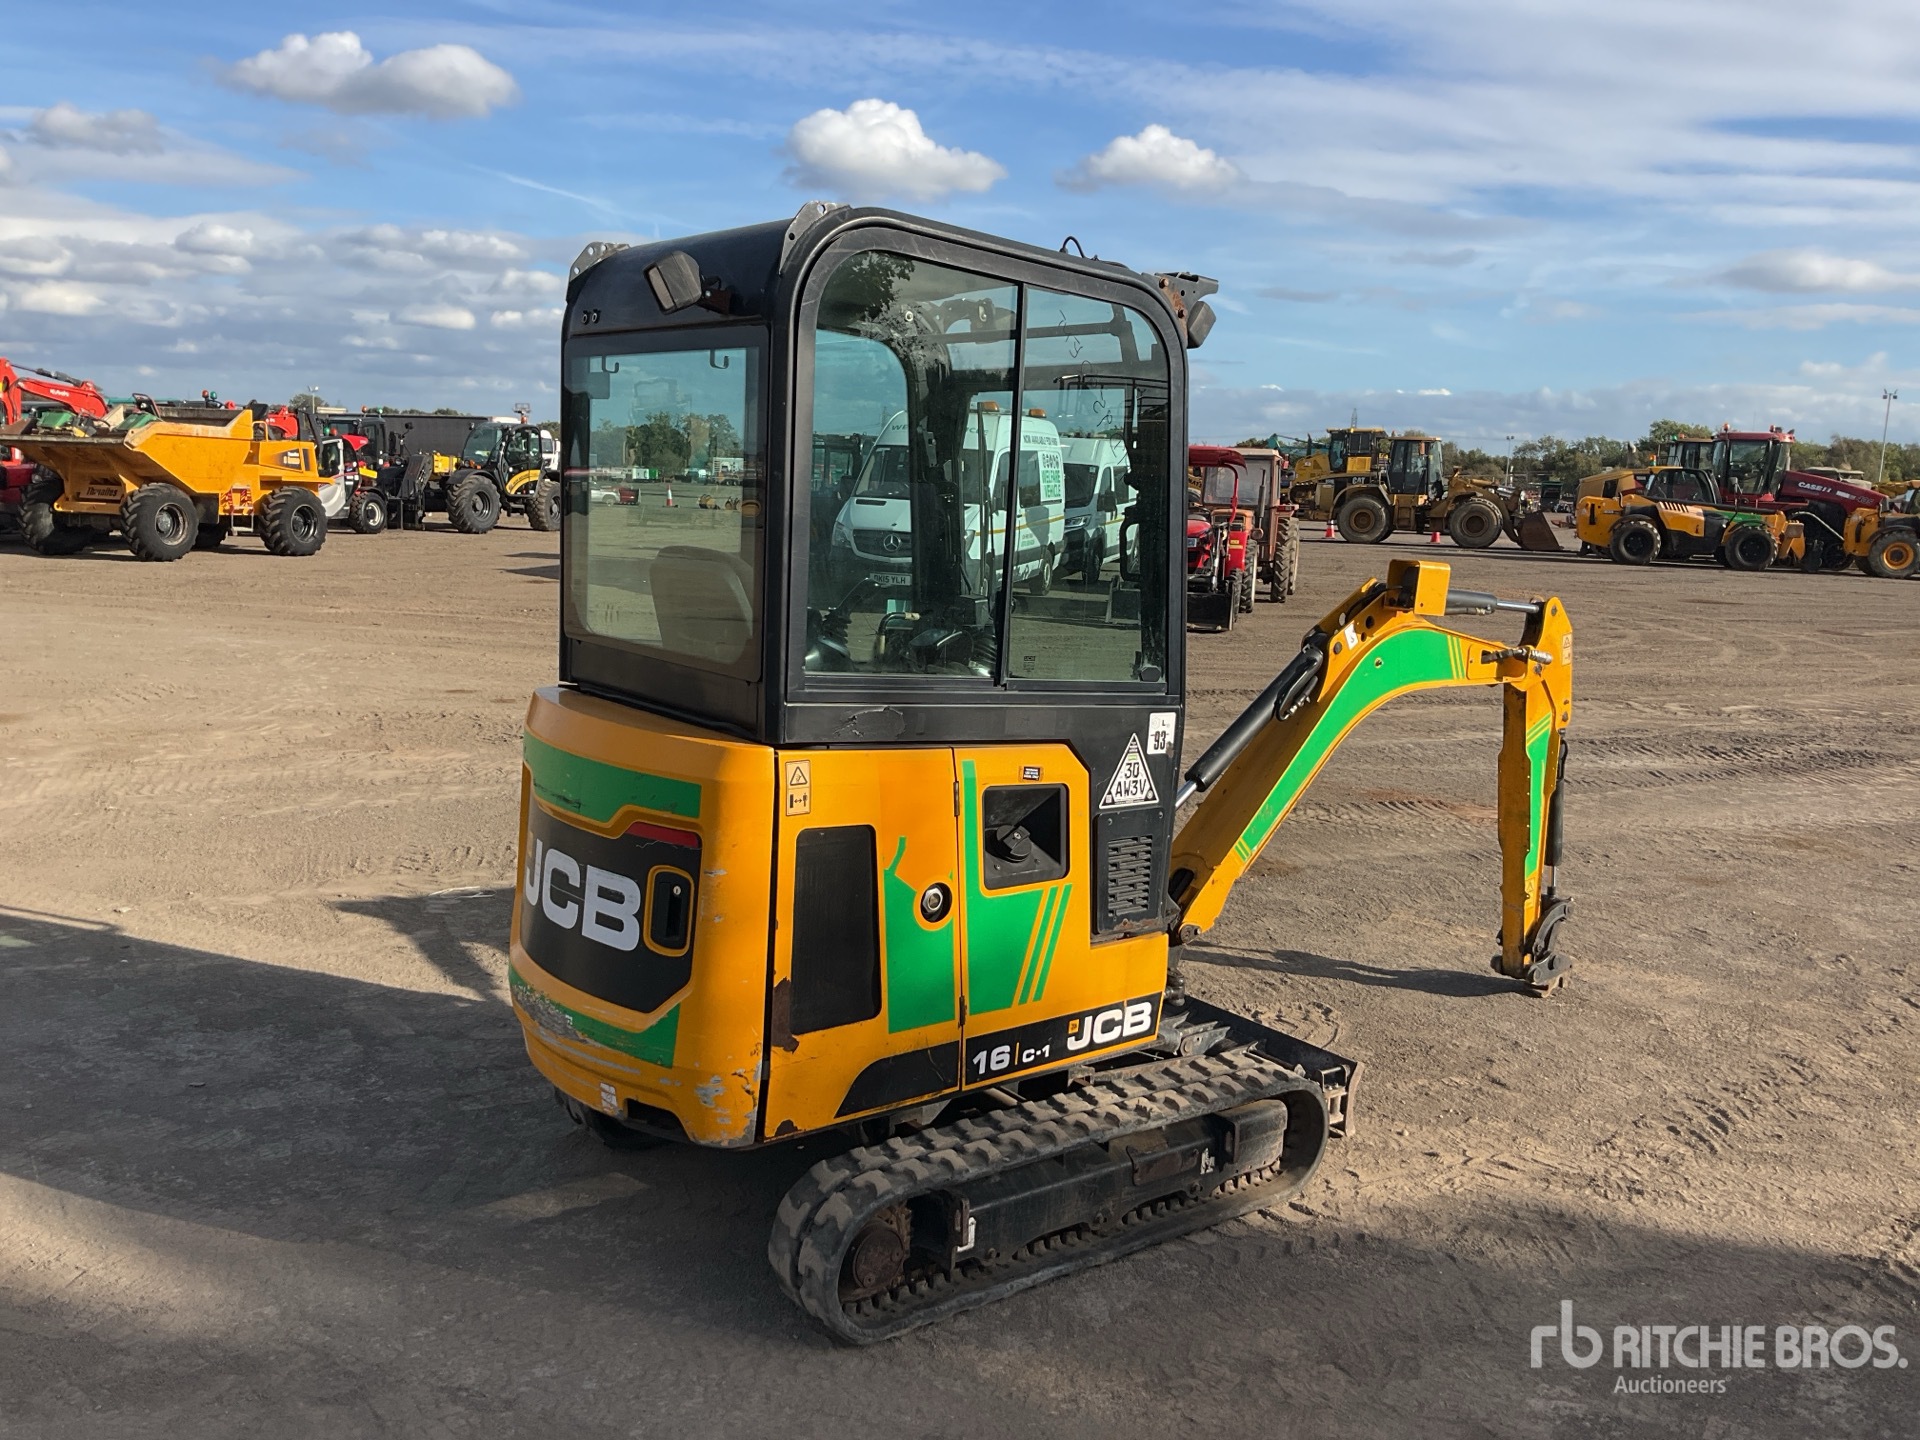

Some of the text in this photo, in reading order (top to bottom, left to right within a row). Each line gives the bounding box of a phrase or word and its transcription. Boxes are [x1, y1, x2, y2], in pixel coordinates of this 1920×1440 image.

[1352, 476, 1366, 485] CAT
[1153, 730, 1167, 751] 93
[525, 838, 641, 951] JCB
[1066, 1001, 1152, 1051] JCB
[972, 1045, 1011, 1075] 16
